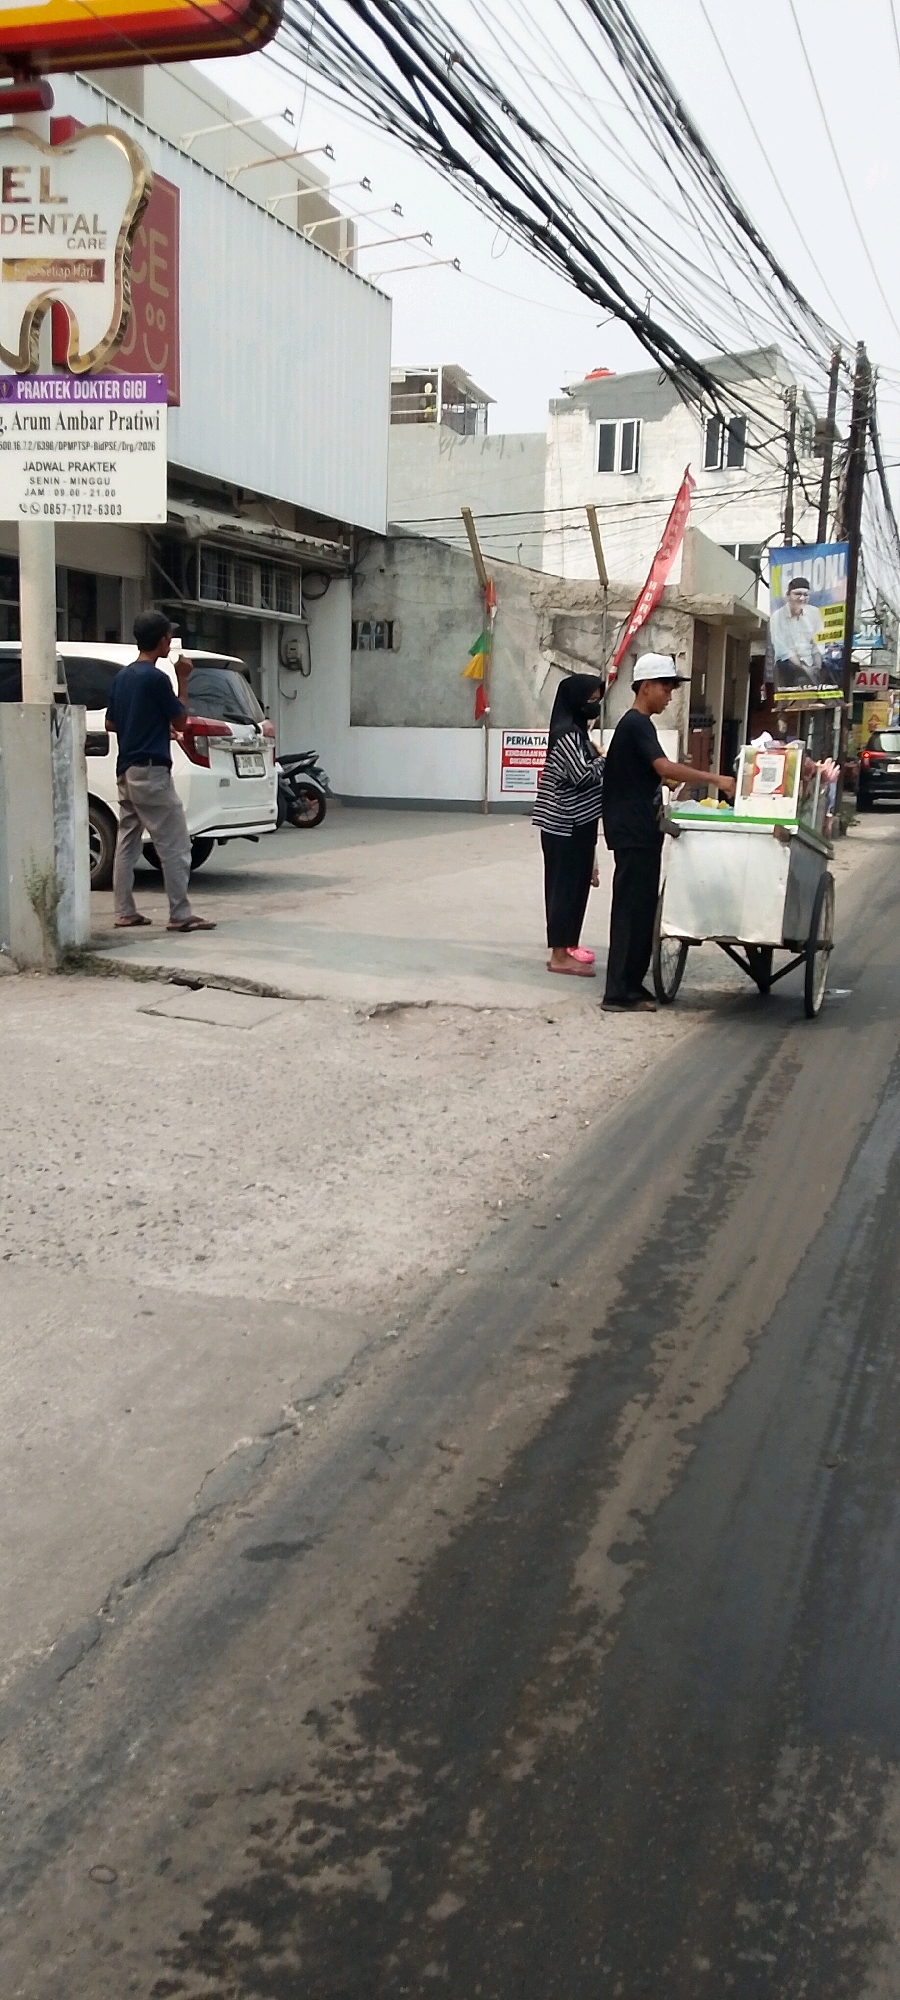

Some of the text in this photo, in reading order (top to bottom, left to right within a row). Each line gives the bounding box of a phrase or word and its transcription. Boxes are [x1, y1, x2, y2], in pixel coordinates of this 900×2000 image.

[0, 213, 107, 235] DENTAL
[66, 237, 107, 250] CARE
[39, 265, 71, 280] Setiap
[73, 264, 94, 278] Hari
[17, 380, 147, 400] PRAKTEK DOKTER GIGI
[11, 410, 51, 431] Arum
[55, 409, 105, 431] Ambar
[109, 409, 160, 431] Pratiwi
[22, 461, 117, 473] JADWAL PRAKTEK
[29, 476, 60, 486] SENIN
[69, 476, 111, 486] MINGGU
[24, 488, 45, 497] JAM
[54, 488, 80, 497] 09.00
[90, 488, 116, 497] 21.00
[43, 503, 122, 516] 0857-1712-6303
[856, 672, 888, 686] AKI
[506, 736, 548, 746] PERHATIA
